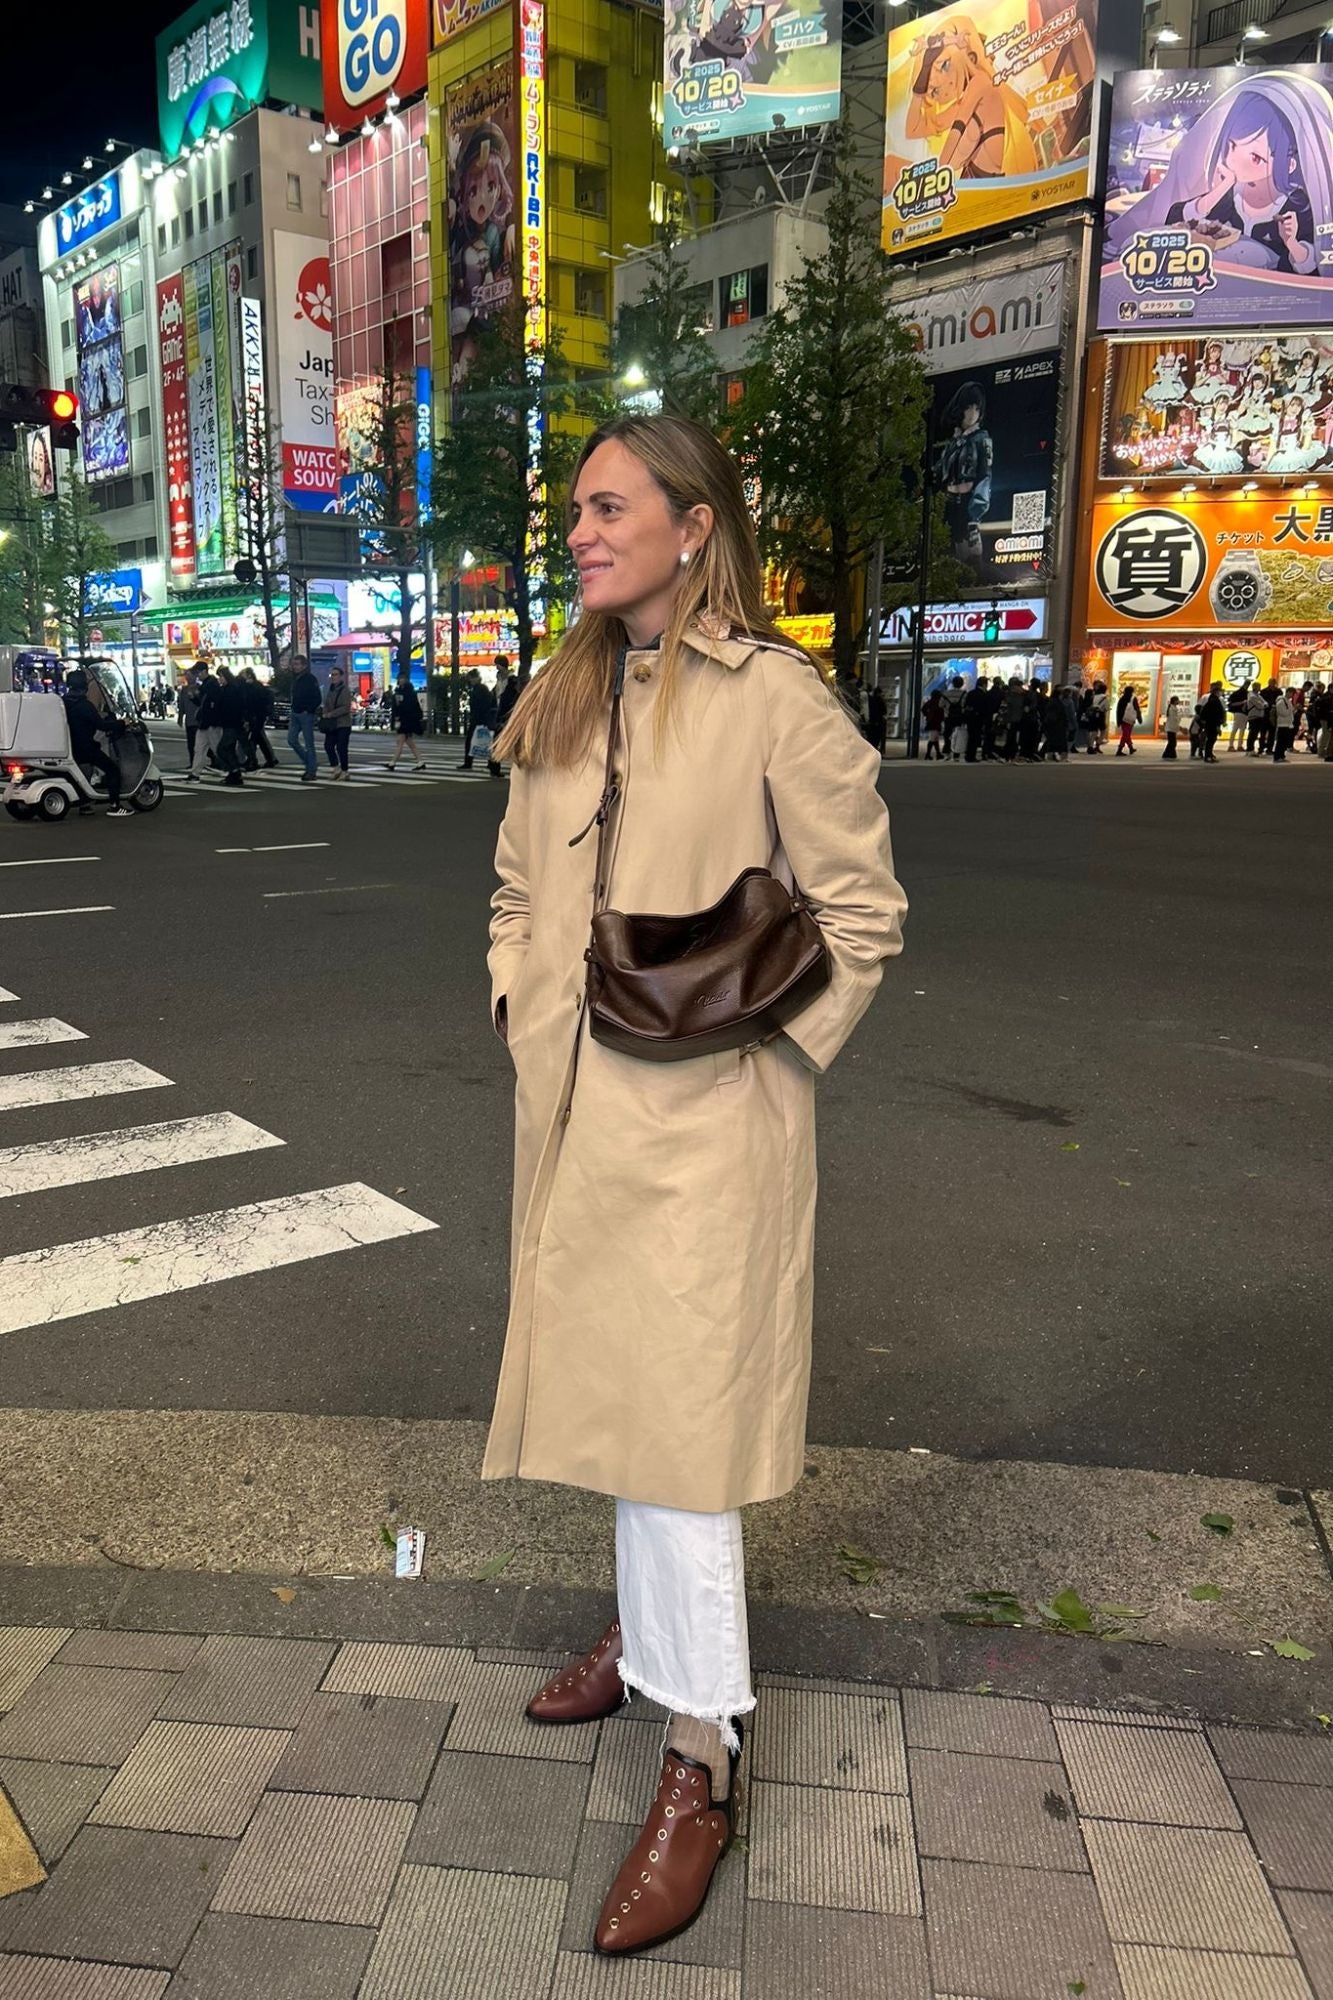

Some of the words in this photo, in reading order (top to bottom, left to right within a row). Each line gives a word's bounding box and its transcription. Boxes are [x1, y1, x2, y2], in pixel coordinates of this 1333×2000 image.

[782, 20, 815, 37] コハク
[345, 13, 400, 92] GO
[694, 63, 721, 77] 2025
[675, 73, 738, 103] 10/20
[1034, 82, 1066, 104] セイナ
[526, 83, 539, 150] ムーラン
[912, 160, 936, 178] 2025
[526, 152, 540, 228] AKIBA
[896, 171, 951, 207] 10/20
[1042, 181, 1076, 197] YOSTAR
[1151, 236, 1186, 247] 2025
[1125, 250, 1206, 276] 10/20
[1135, 277, 1193, 288] サービス開始
[904, 292, 1043, 351] amiami
[244, 302, 260, 366] AKKY
[162, 335, 184, 365] GAME
[299, 350, 334, 378] Jap
[995, 369, 1011, 379] EZ
[1024, 360, 1053, 374] APEX
[295, 378, 334, 401] Tax-
[311, 405, 335, 426] Sh
[292, 449, 335, 470] WATC
[294, 470, 336, 488] SOUV
[995, 536, 1043, 551] amiami
[1217, 532, 1264, 544] チケット
[1109, 526, 1193, 604] 質
[879, 612, 914, 642] ZIN
[923, 613, 977, 632] COMIC
[1228, 657, 1257, 682] 質
